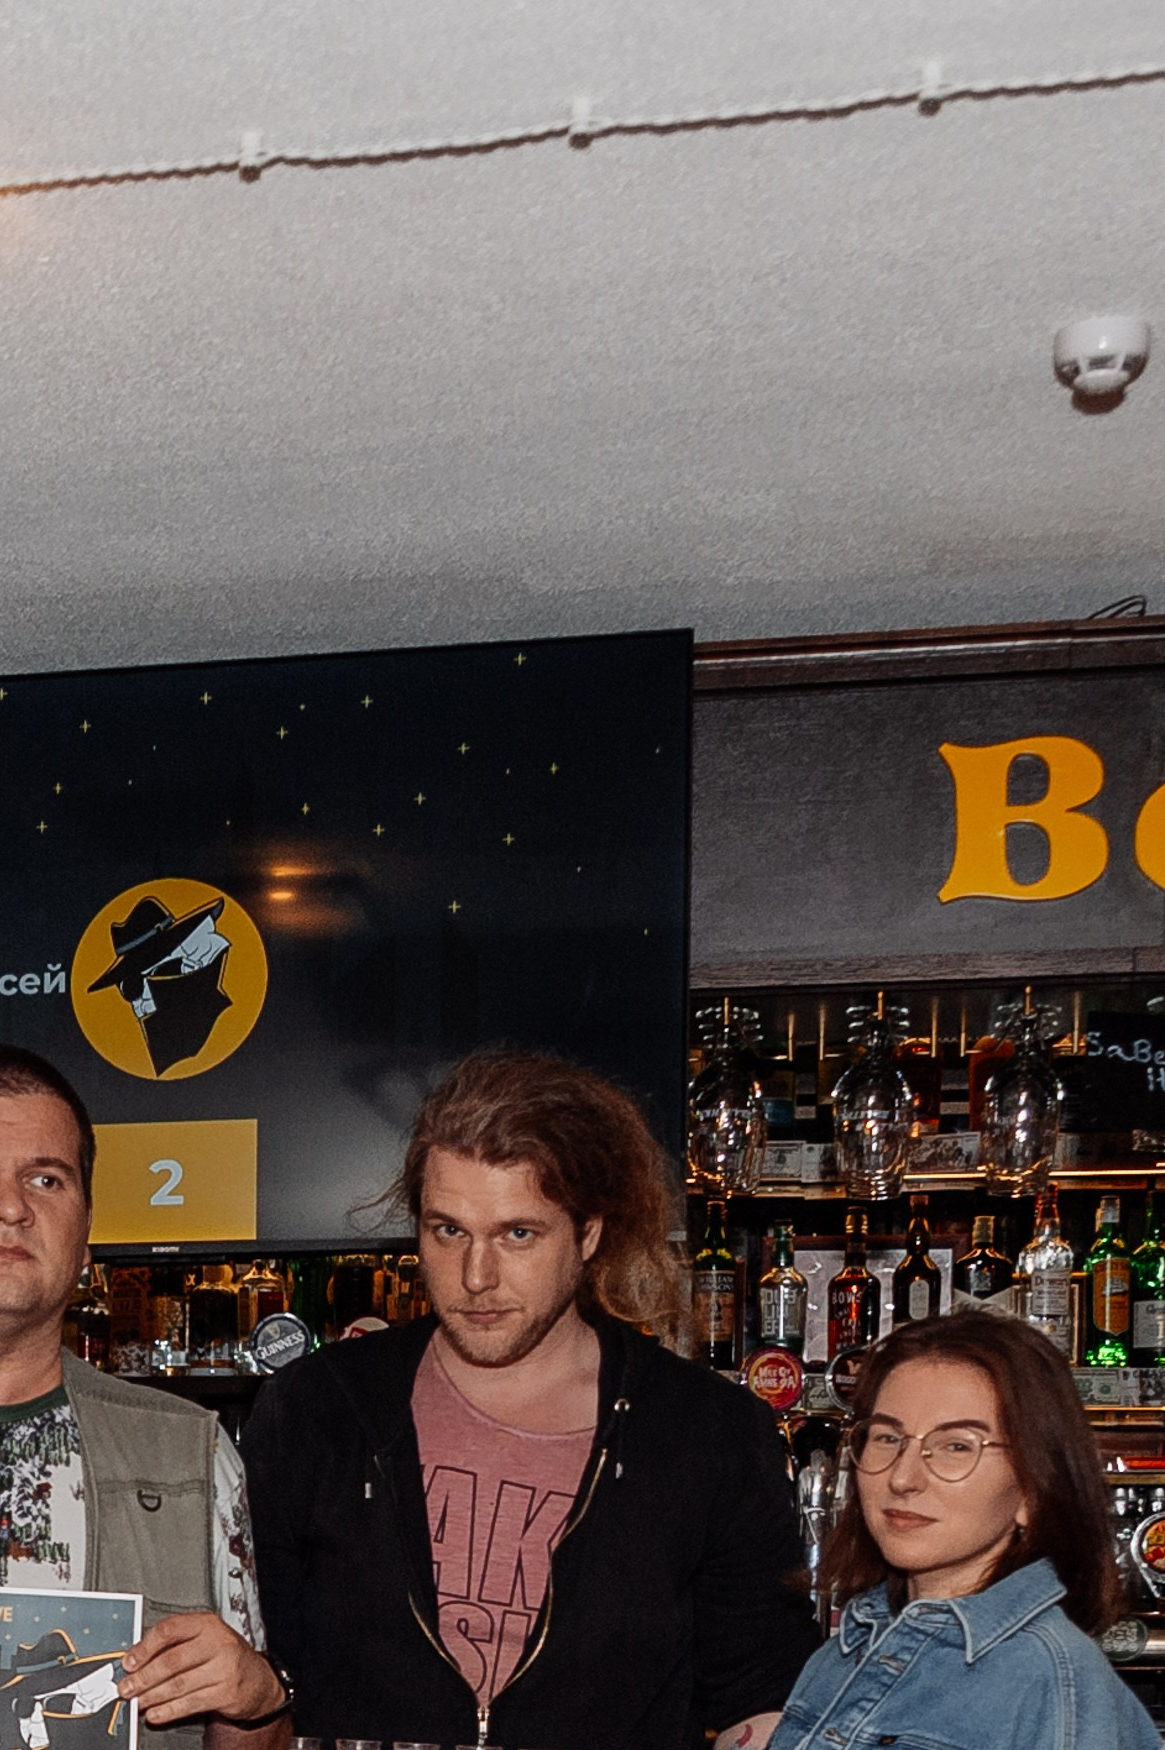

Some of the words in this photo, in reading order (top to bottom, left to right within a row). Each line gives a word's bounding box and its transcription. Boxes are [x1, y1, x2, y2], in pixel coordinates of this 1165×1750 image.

[938, 735, 1165, 905] B
[148, 1159, 184, 1206] 2
[255, 1329, 306, 1360] GUINNESS
